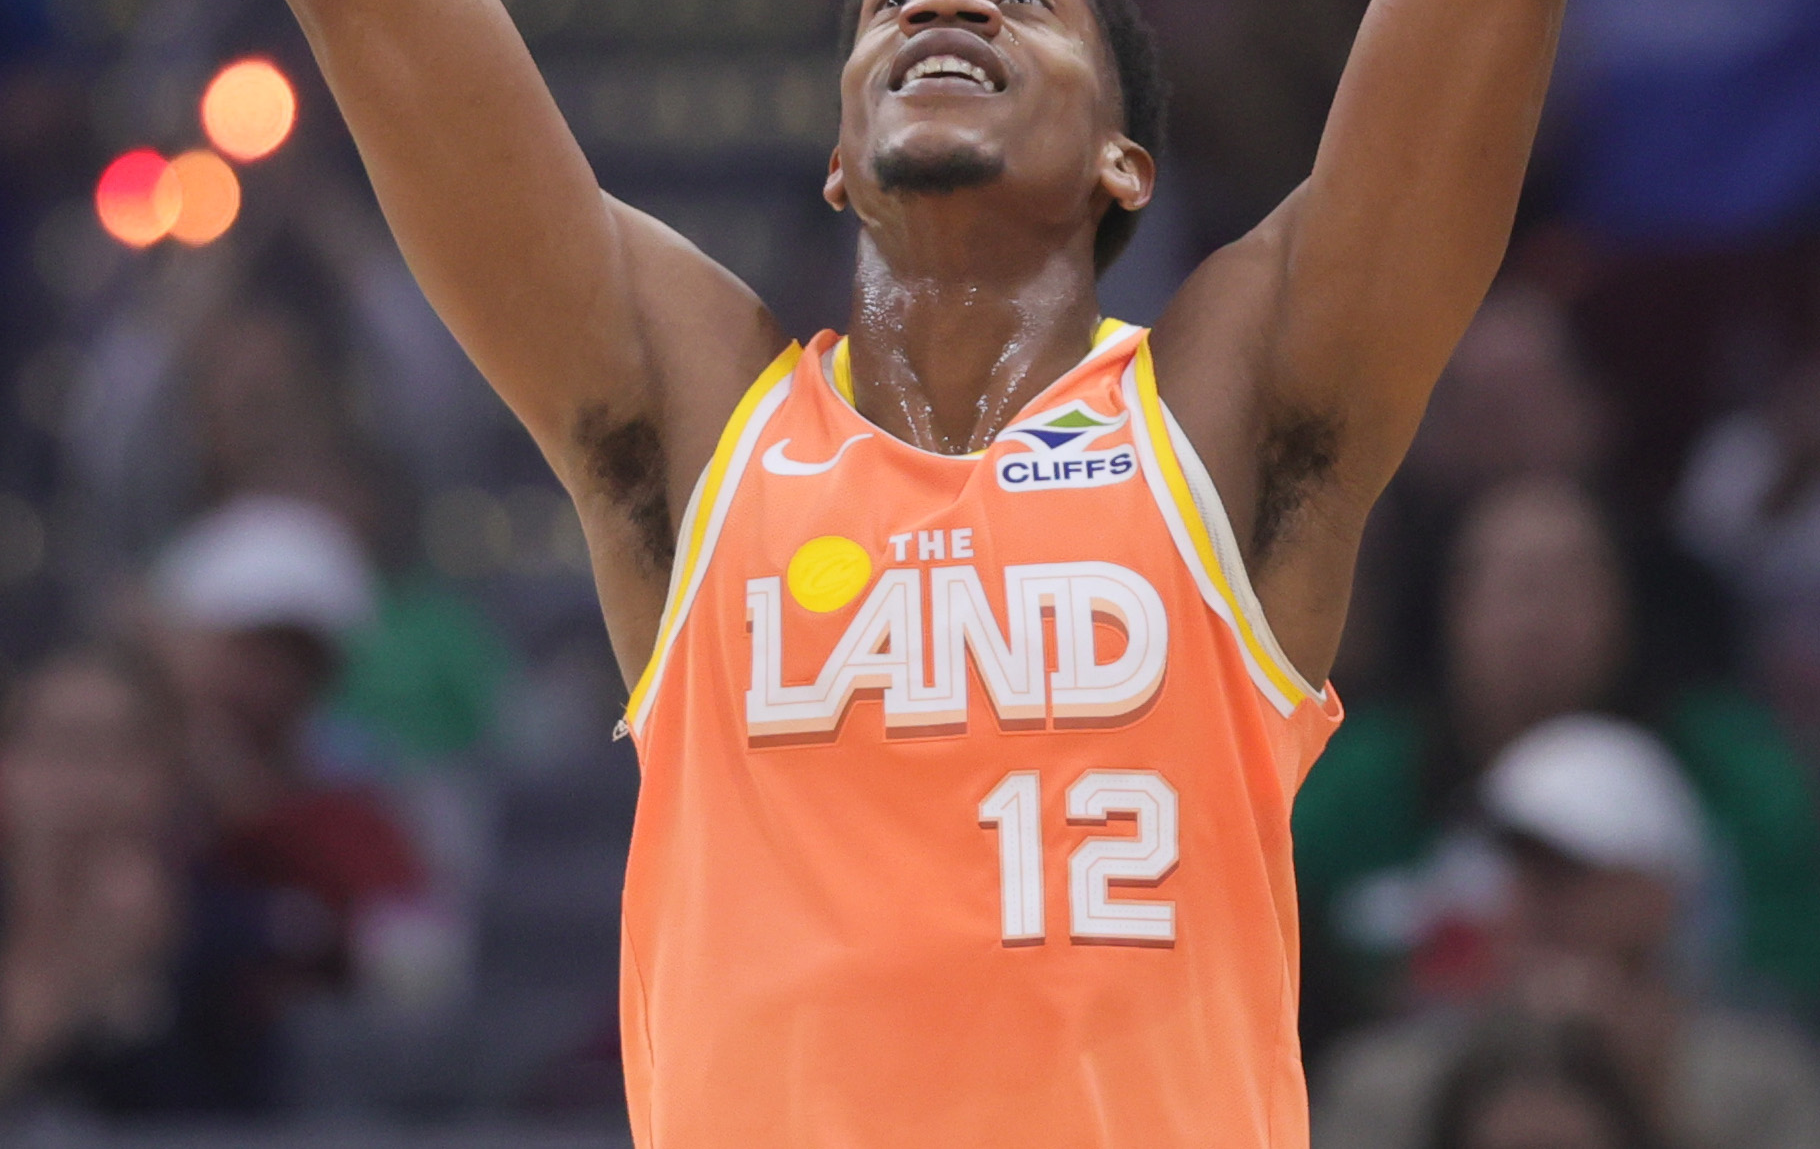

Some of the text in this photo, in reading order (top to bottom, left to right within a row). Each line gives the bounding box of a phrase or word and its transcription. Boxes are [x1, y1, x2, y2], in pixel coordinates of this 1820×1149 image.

[1002, 452, 1133, 484] CLIFFS
[889, 528, 974, 561] THE
[745, 561, 1168, 746] LAND
[978, 769, 1179, 947] 12
